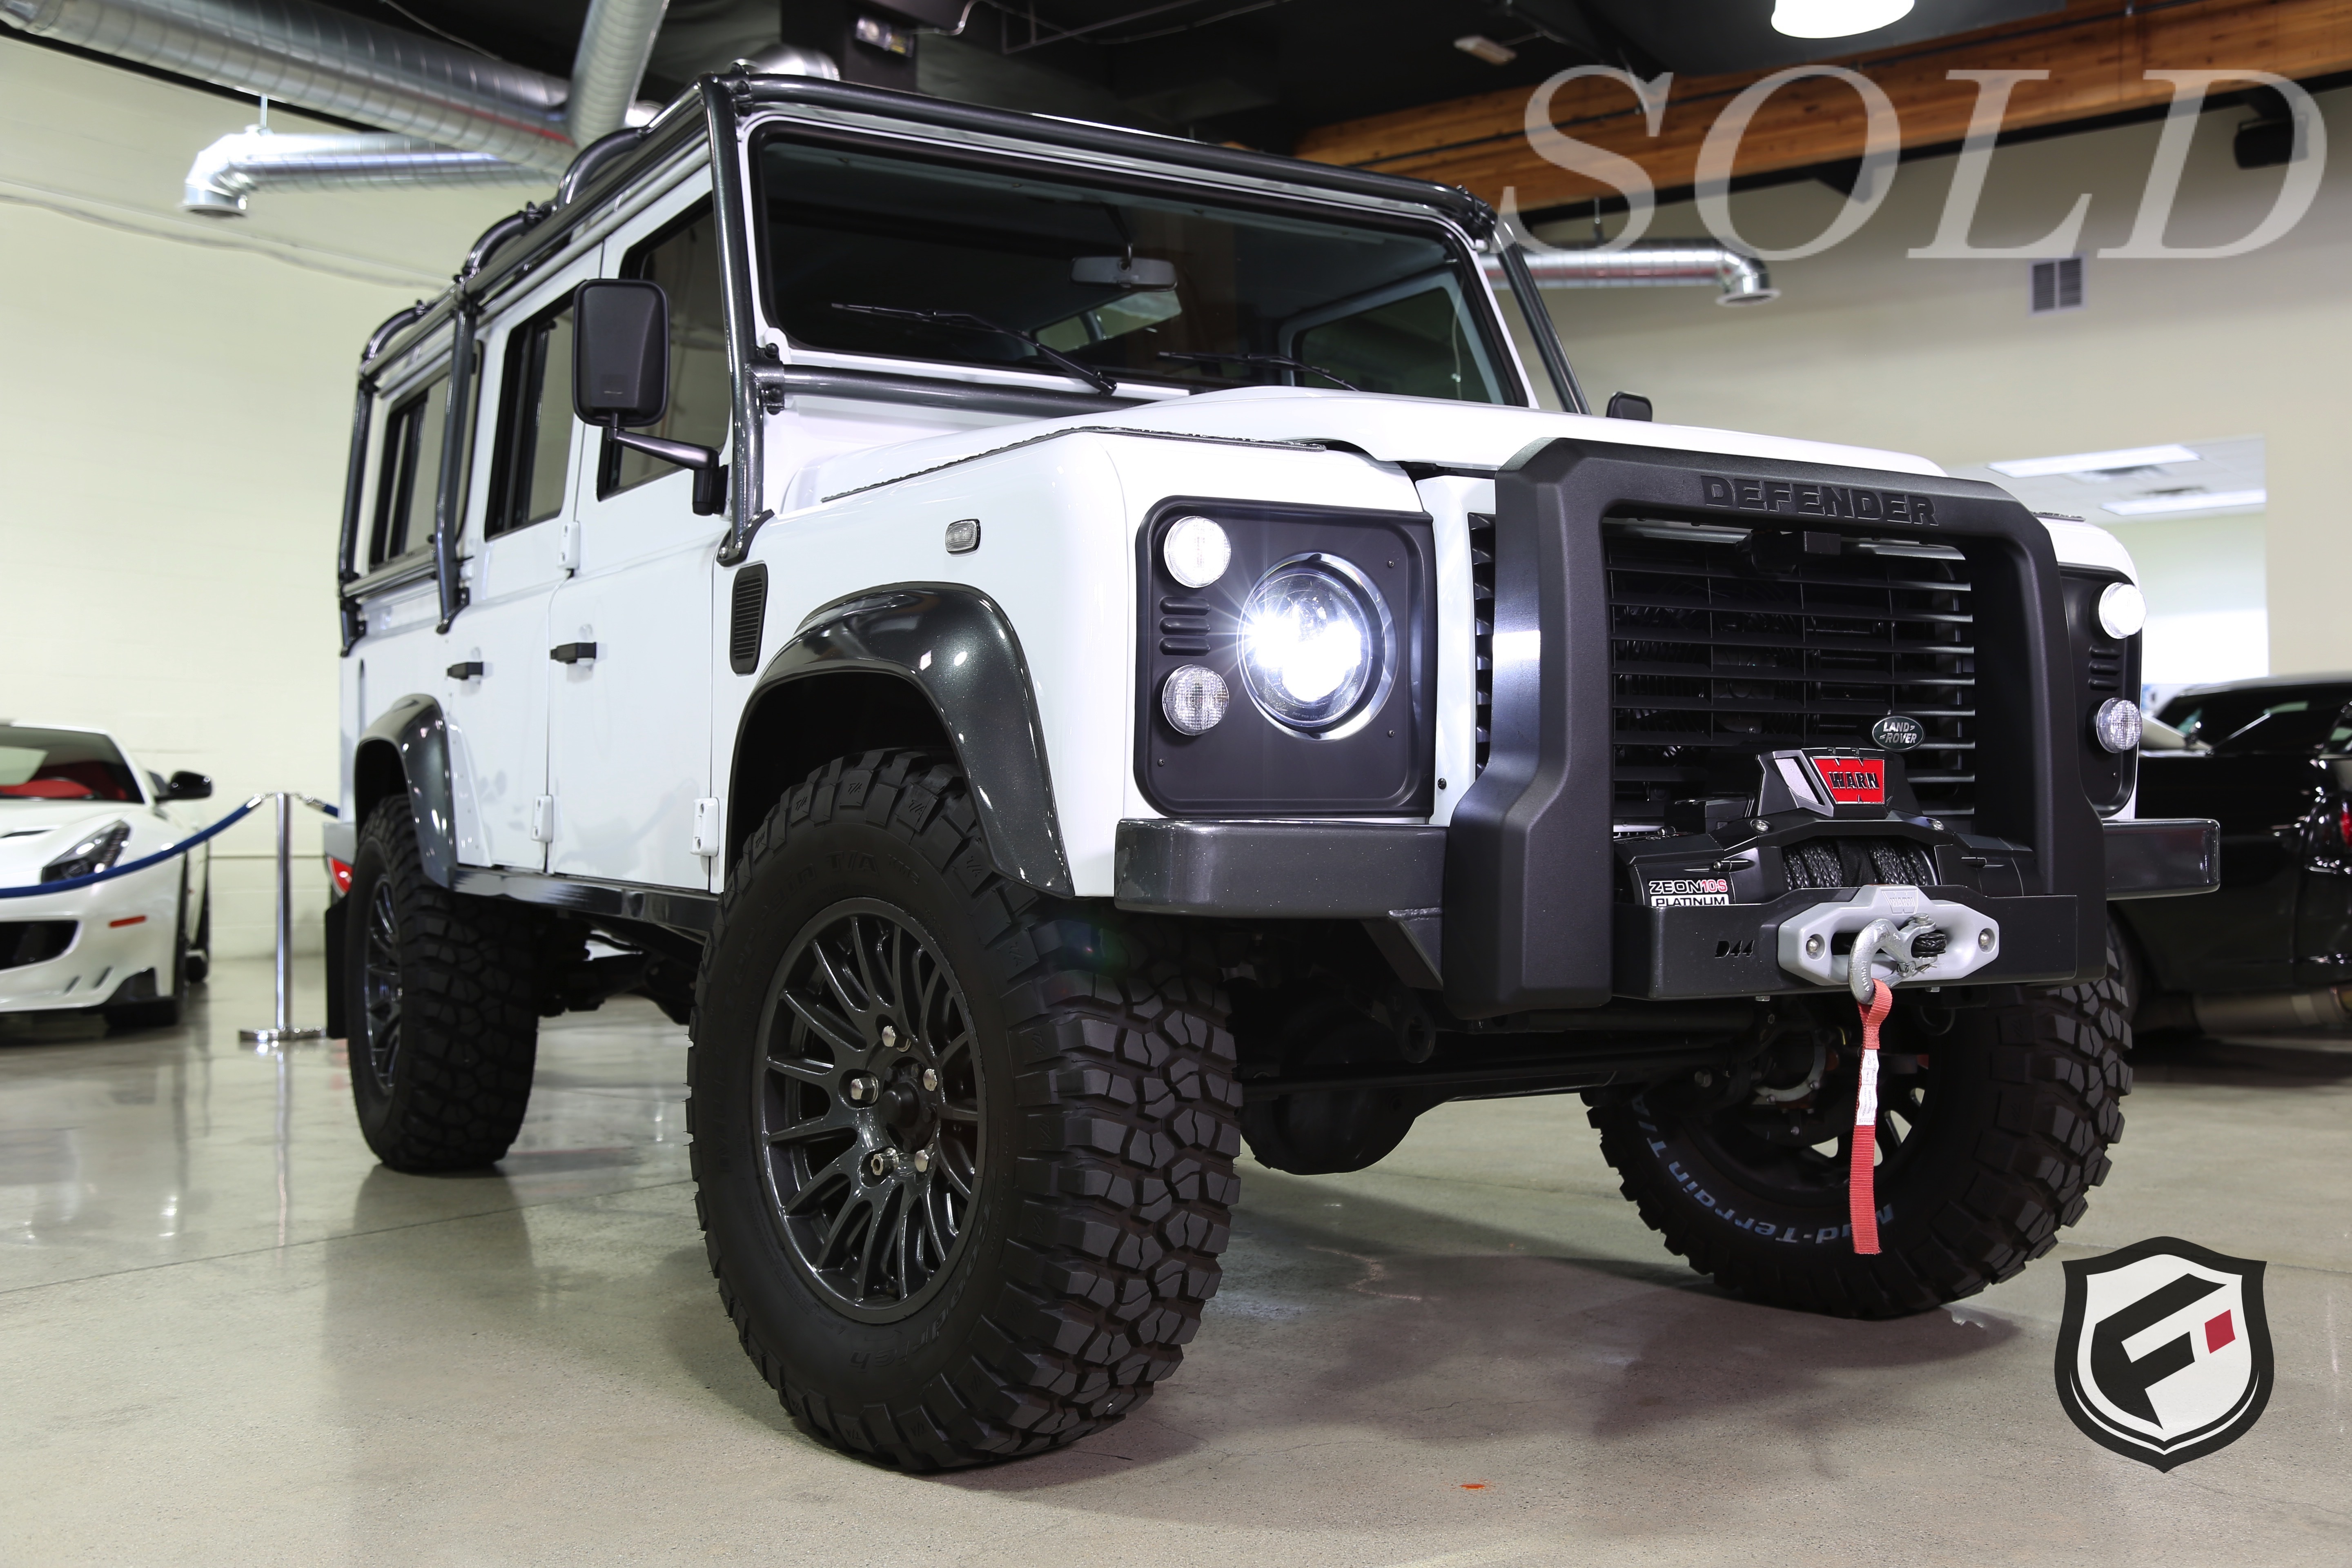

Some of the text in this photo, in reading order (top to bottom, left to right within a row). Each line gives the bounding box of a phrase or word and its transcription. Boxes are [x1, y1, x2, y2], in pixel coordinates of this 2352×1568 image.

[1701, 474, 1939, 526] DEFENDER
[1883, 722, 1909, 732] LAND
[1885, 733, 1917, 744] ROVER
[1827, 771, 1880, 790] WARN
[824, 849, 880, 876] T/A
[1655, 896, 1725, 906] PLATINUM
[1889, 897, 1915, 907] WARN
[1714, 939, 1755, 959] D44
[1631, 1094, 1667, 1158] T/A
